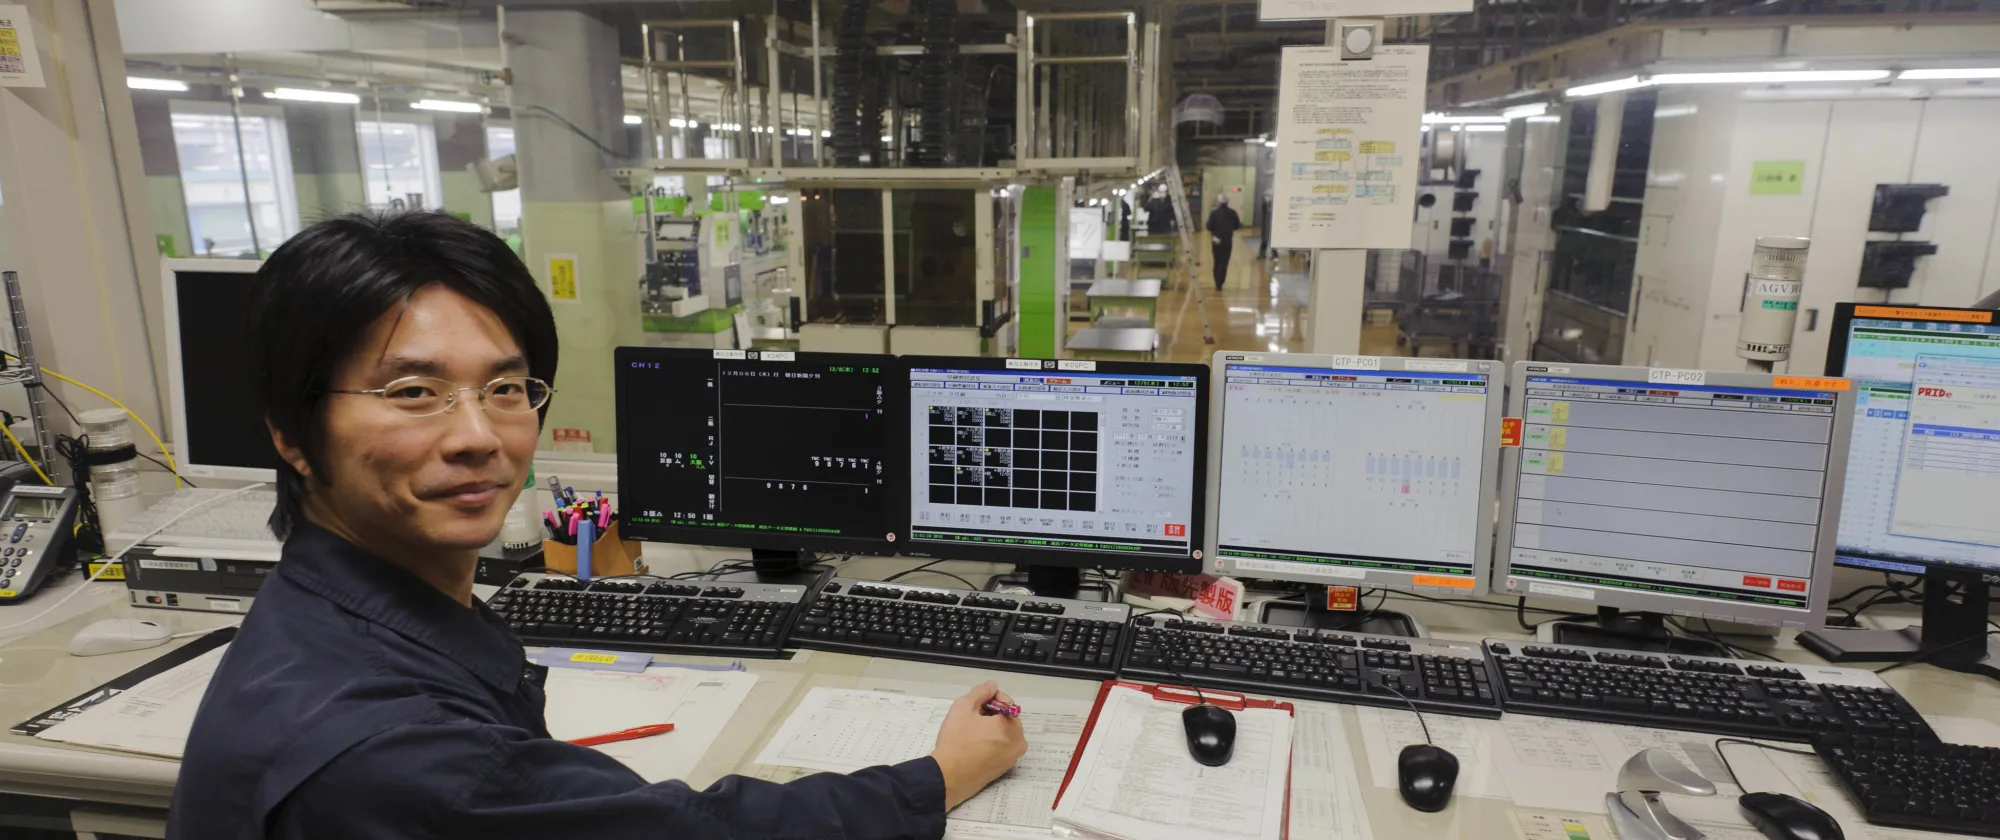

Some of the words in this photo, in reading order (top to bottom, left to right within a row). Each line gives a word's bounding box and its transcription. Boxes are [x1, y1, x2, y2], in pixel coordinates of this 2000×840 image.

[631, 361, 660, 369] CH12
[1335, 357, 1377, 367] CTP-PC01
[1651, 369, 1703, 382] CTP-PC02
[1917, 387, 1952, 398] PRIDe
